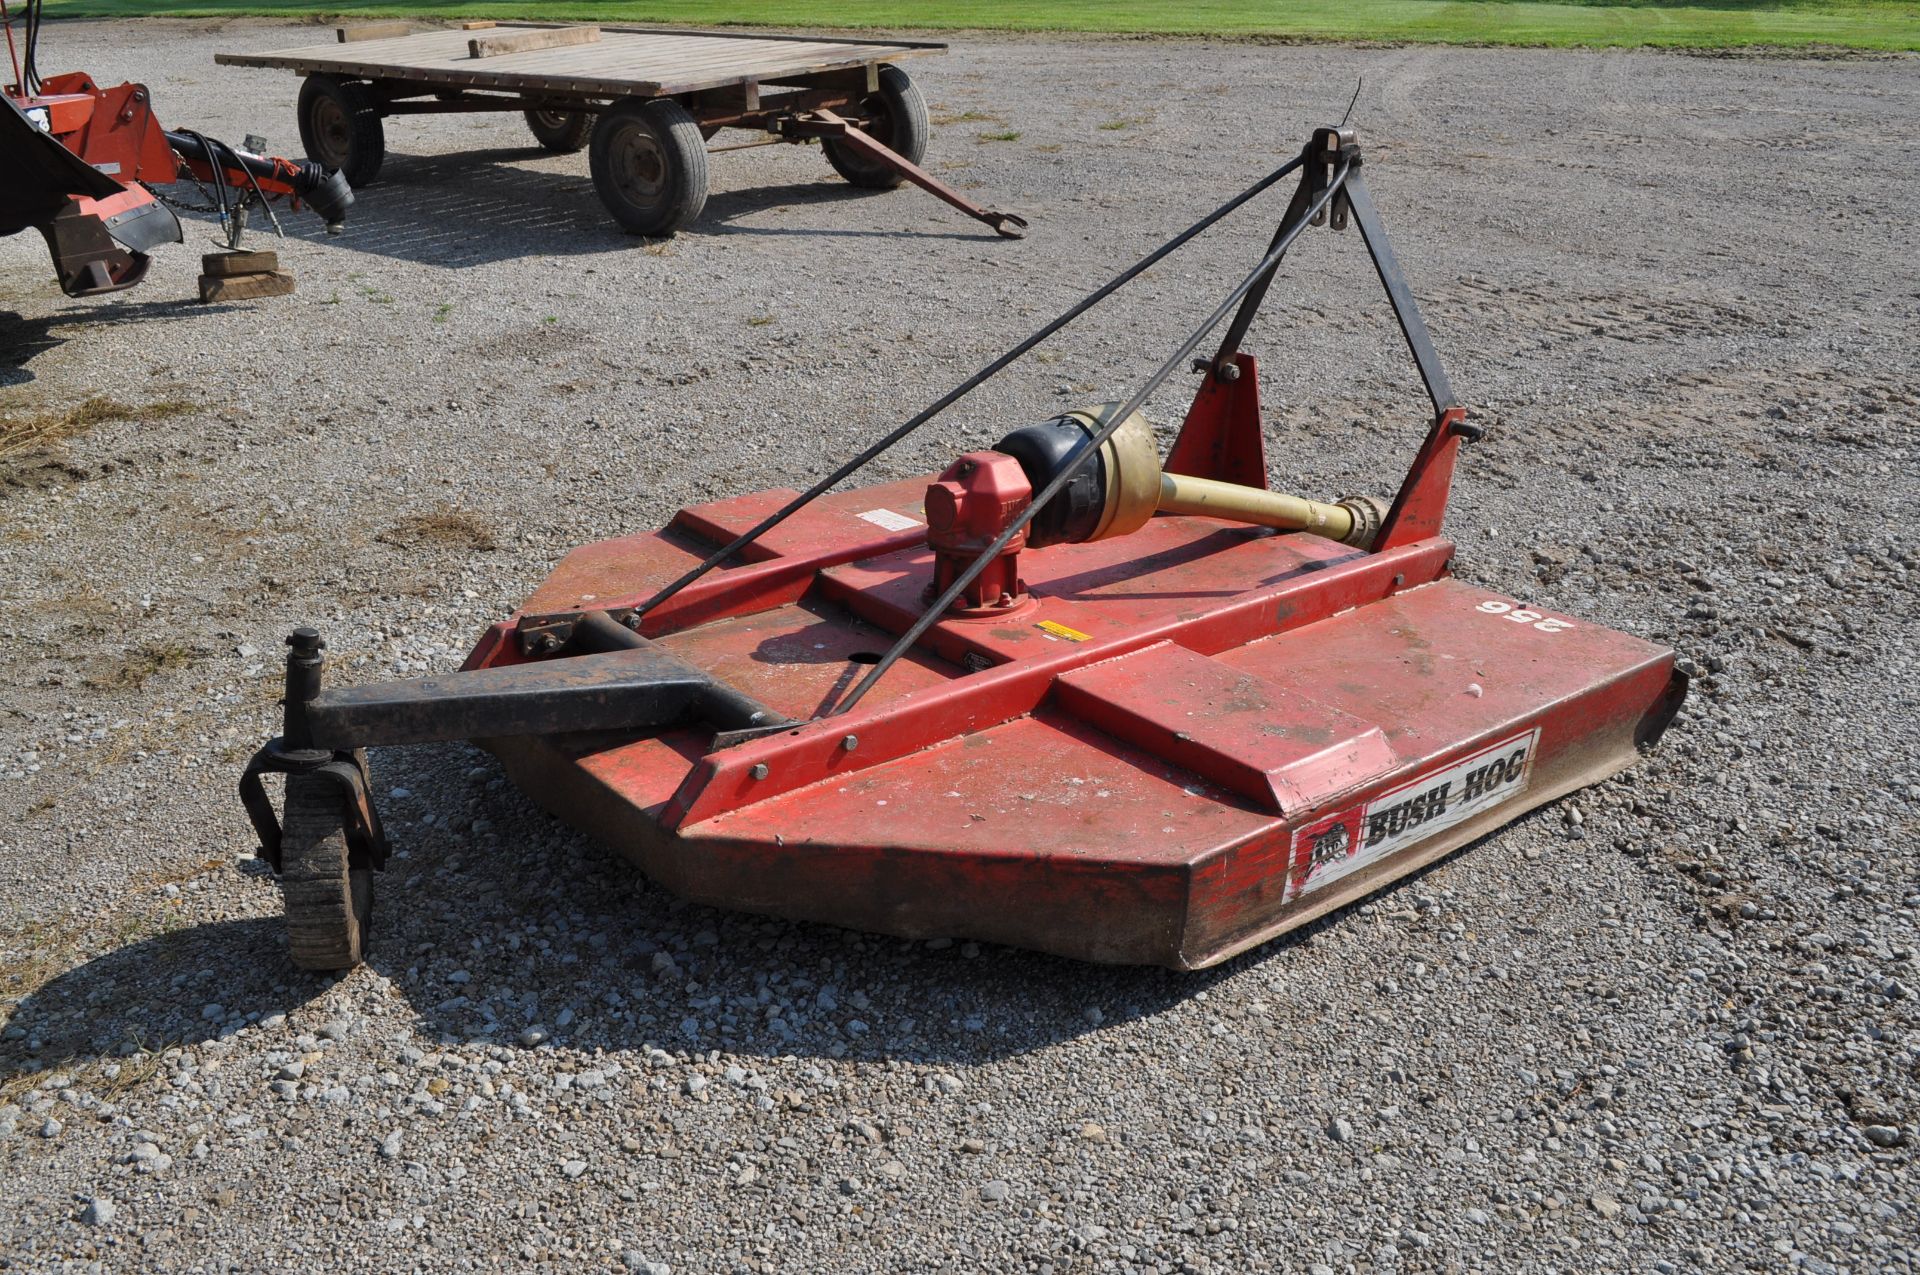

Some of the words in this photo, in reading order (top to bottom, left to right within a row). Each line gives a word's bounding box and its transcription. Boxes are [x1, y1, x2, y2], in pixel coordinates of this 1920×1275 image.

[1475, 601, 1575, 632] 256
[1364, 781, 1452, 849] BUSH
[1463, 748, 1526, 804] HOG
